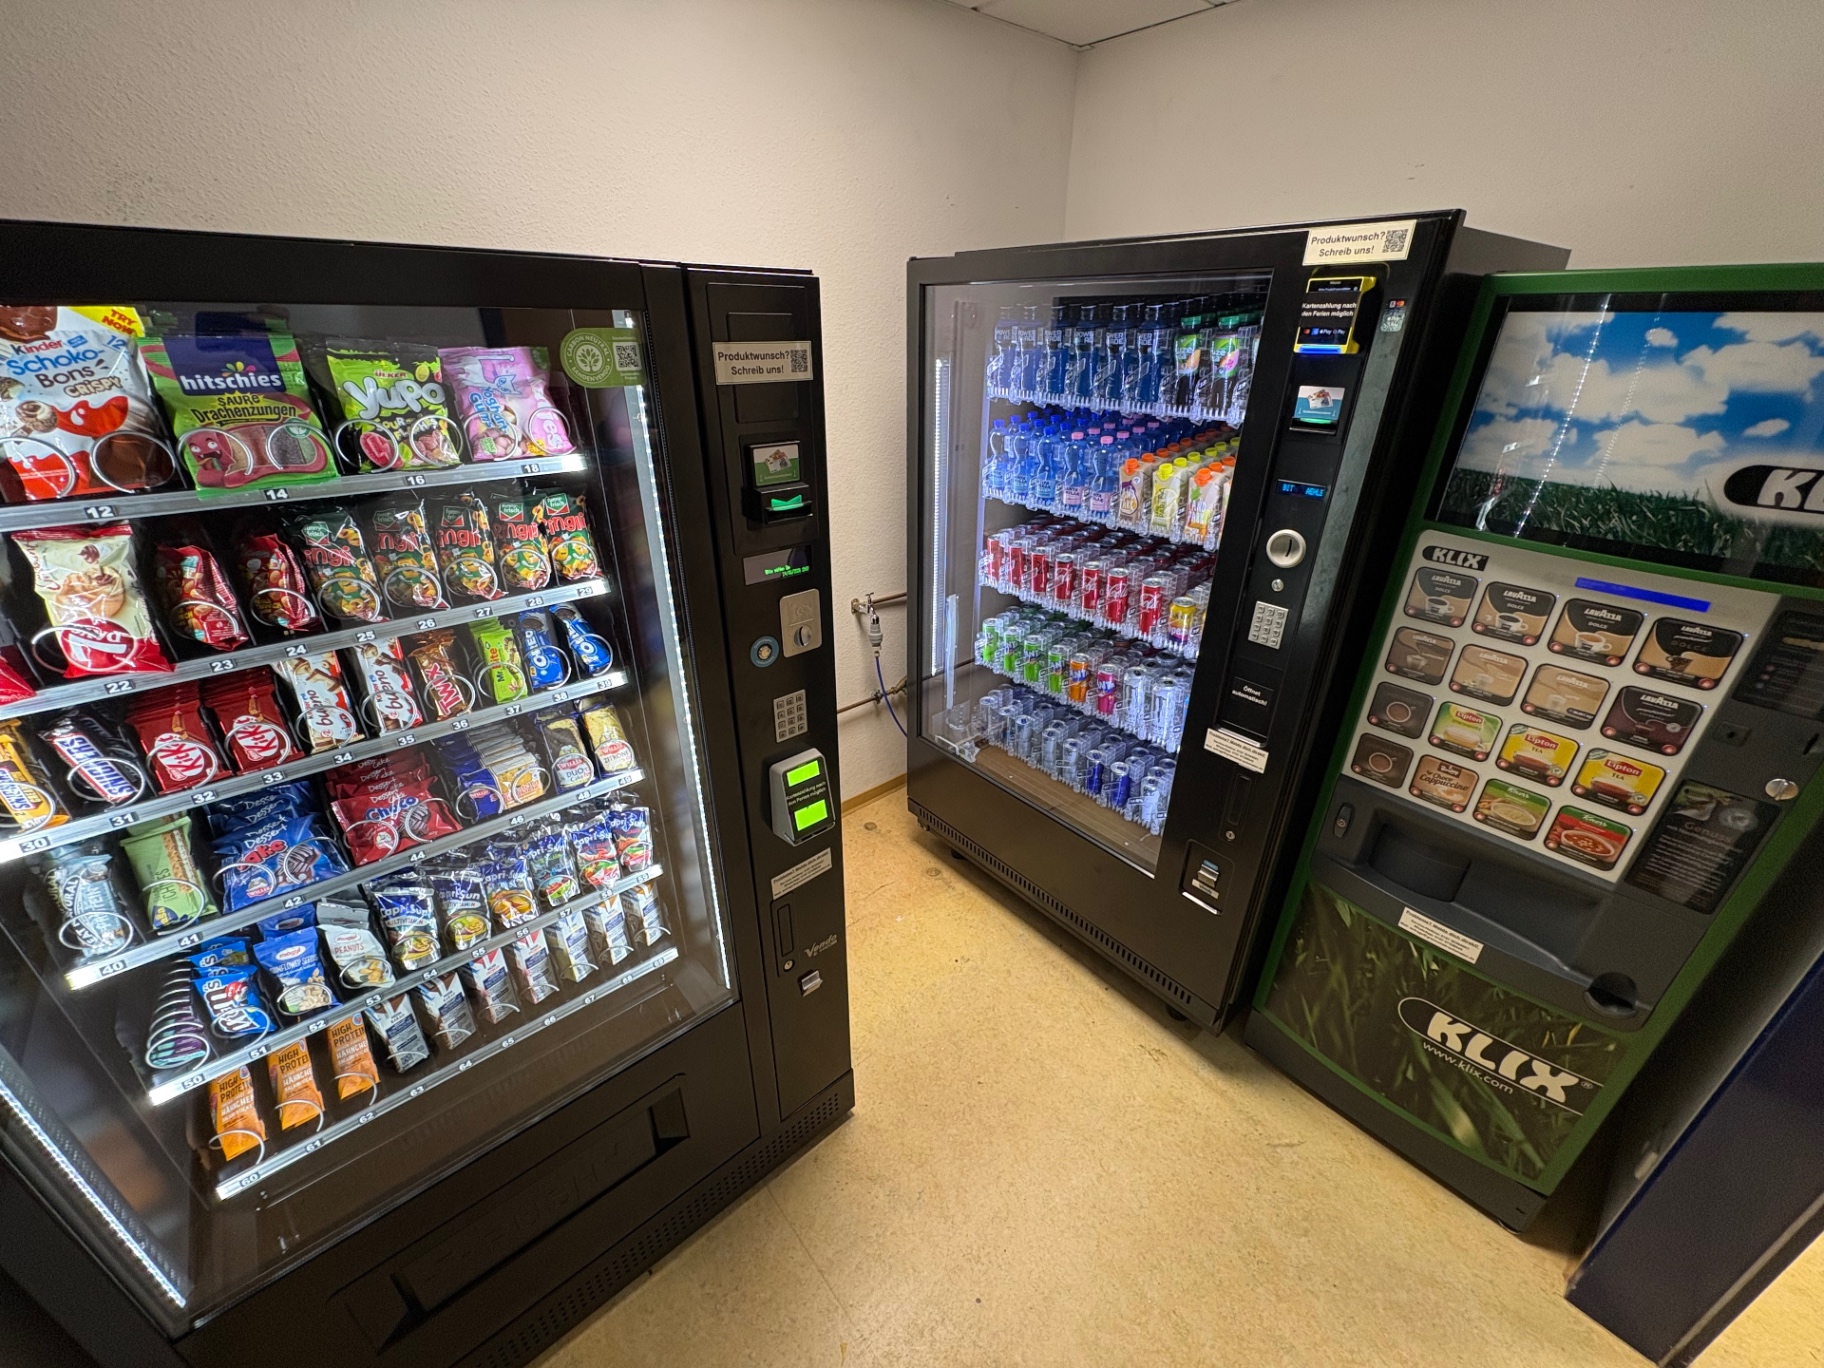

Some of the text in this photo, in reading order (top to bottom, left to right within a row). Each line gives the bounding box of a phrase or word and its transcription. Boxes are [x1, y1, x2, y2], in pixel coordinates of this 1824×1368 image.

[1311, 231, 1385, 245] Produktwunsch?
[1319, 245, 1375, 257] Schreib uns!
[1302, 302, 1341, 310] Kartenzahlung
[110, 309, 137, 325] TRY
[1331, 310, 1354, 318] möglich
[102, 316, 136, 335] NOW
[566, 335, 610, 357] CARBON NEUTRAL
[717, 350, 790, 362] Produktwunsch?
[6, 349, 105, 376] Schoko-
[731, 365, 784, 376] Schreib uns!
[35, 366, 95, 388] Bons
[180, 373, 281, 391] hitschies
[191, 405, 296, 424] Drachenzungen
[524, 464, 539, 473] 18
[407, 476, 425, 486] 16
[265, 489, 287, 500] 14
[87, 507, 114, 519] 12
[1432, 547, 1483, 570] KLIX
[580, 587, 593, 596] 29
[1503, 590, 1537, 603] LAVAZZA
[529, 597, 543, 606] 28
[476, 607, 491, 617] 27
[1584, 607, 1622, 621] LAVAZZA
[418, 619, 435, 629] 26
[1588, 621, 1608, 630] DOLCE
[356, 631, 375, 642] 25
[286, 645, 307, 656] 24
[212, 660, 234, 671] 23
[107, 681, 132, 693] 22
[599, 679, 611, 688] 39
[554, 692, 567, 701] 38
[1243, 685, 1261, 697] Öffnet
[1231, 689, 1268, 706] automatisch!
[1639, 694, 1679, 710] LAVAZZA
[507, 705, 521, 715] 37
[1455, 711, 1483, 724] Lipton
[452, 720, 469, 729] 36
[398, 735, 415, 745] 35
[1525, 733, 1558, 749] Lipton
[334, 752, 353, 764] 34
[1606, 759, 1641, 776] Lipton
[263, 772, 283, 784] 33
[1432, 772, 1454, 783] Choco
[1612, 772, 1625, 781] TEA
[1420, 774, 1470, 792] Cappuccino
[193, 790, 215, 803] 32
[577, 792, 590, 801] 48
[112, 813, 134, 826] 31
[510, 816, 524, 825] 46
[245, 824, 287, 848] Dessert
[22, 839, 48, 850] 30
[410, 851, 426, 862] 44
[284, 897, 303, 908] 42
[560, 908, 572, 918] 57
[516, 929, 529, 938] 56
[180, 934, 200, 946] 41
[472, 948, 486, 958] 55
[101, 962, 125, 975] 40
[423, 969, 438, 980] 54
[366, 995, 382, 1006] 53
[584, 995, 596, 1004] 67
[308, 1021, 326, 1032] 52
[544, 1016, 556, 1026] 66
[332, 1022, 353, 1039] HIGH
[502, 1037, 515, 1047] 65
[250, 1047, 268, 1058] 51
[278, 1048, 299, 1065] HIGH
[1427, 1011, 1579, 1103] KLIX
[458, 1060, 473, 1071] 64
[1423, 1041, 1514, 1095] www.klix.com
[183, 1075, 202, 1088] 50
[220, 1076, 238, 1093] HIGH
[410, 1086, 425, 1097] 63
[359, 1112, 374, 1124] 62
[306, 1140, 322, 1152] 61
[240, 1175, 259, 1187] 60
